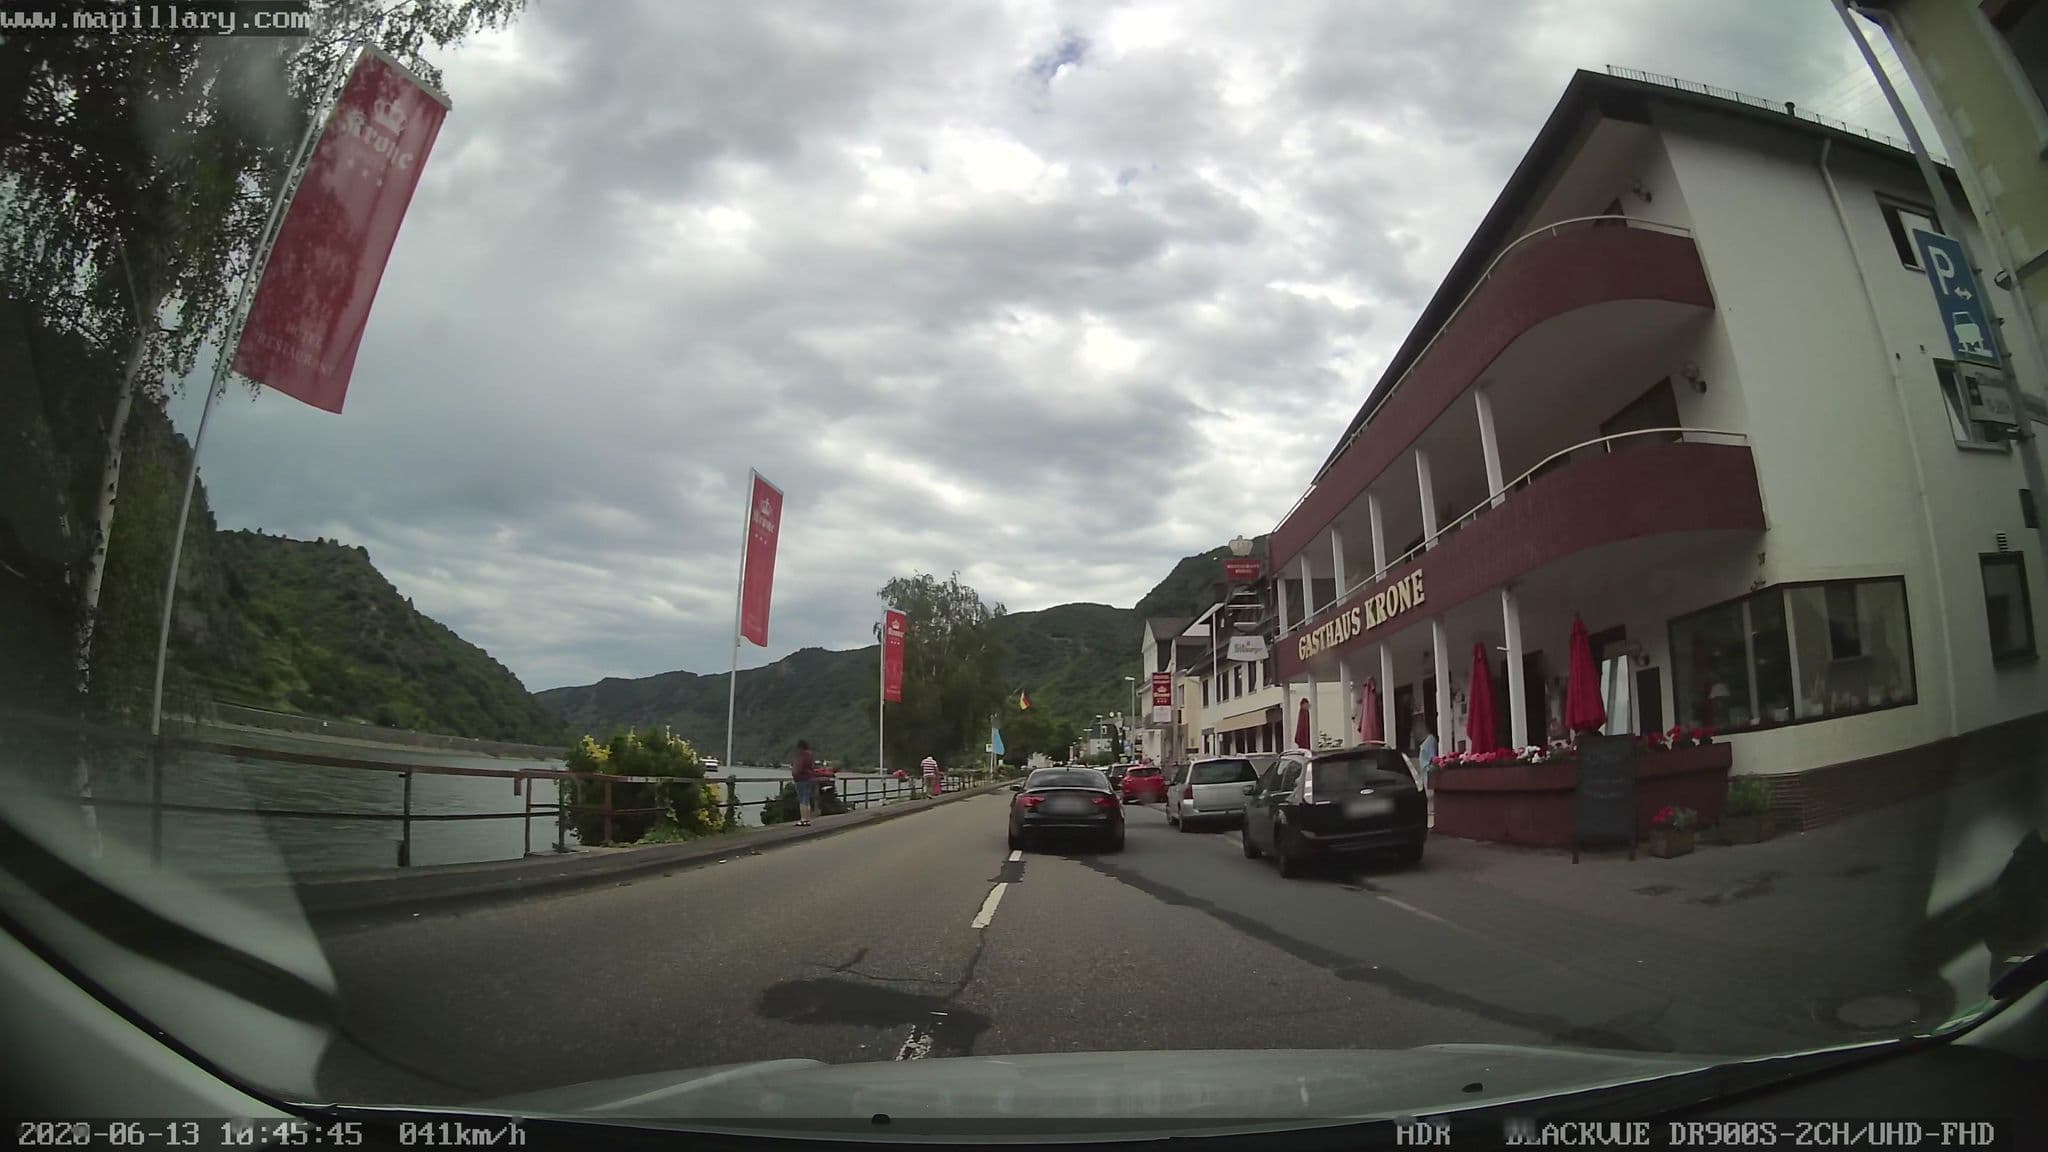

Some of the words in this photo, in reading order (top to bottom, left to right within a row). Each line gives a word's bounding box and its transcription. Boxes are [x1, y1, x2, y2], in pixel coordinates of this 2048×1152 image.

[1928, 246, 1955, 295] P
[1298, 606, 1361, 661] GASTHAUS
[1364, 568, 1425, 631] KRONE
